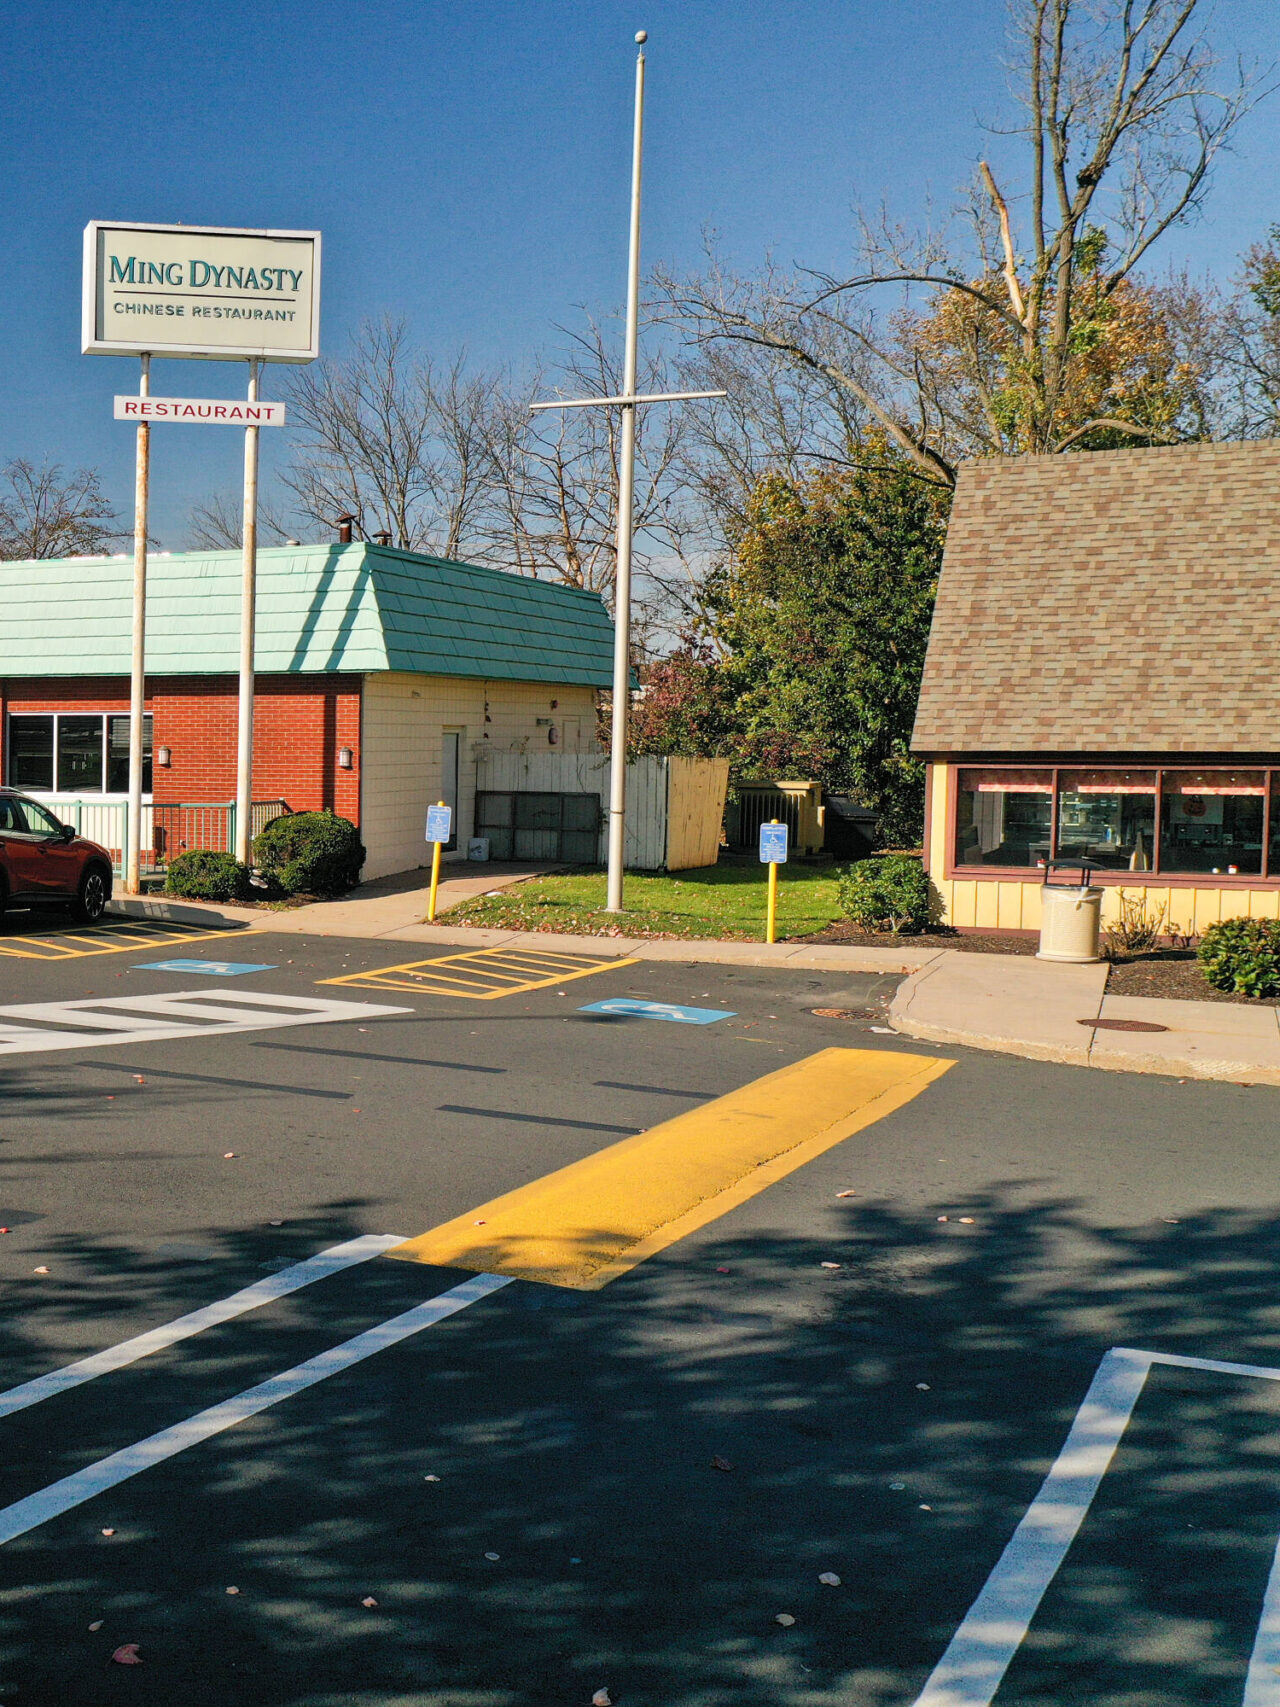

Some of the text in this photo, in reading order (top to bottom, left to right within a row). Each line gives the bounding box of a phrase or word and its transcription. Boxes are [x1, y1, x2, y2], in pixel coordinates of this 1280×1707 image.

[109, 255, 303, 291] MING DYNASTY
[113, 302, 296, 321] CHINESE RESTAURANT
[125, 402, 275, 420] RESTAURANT
